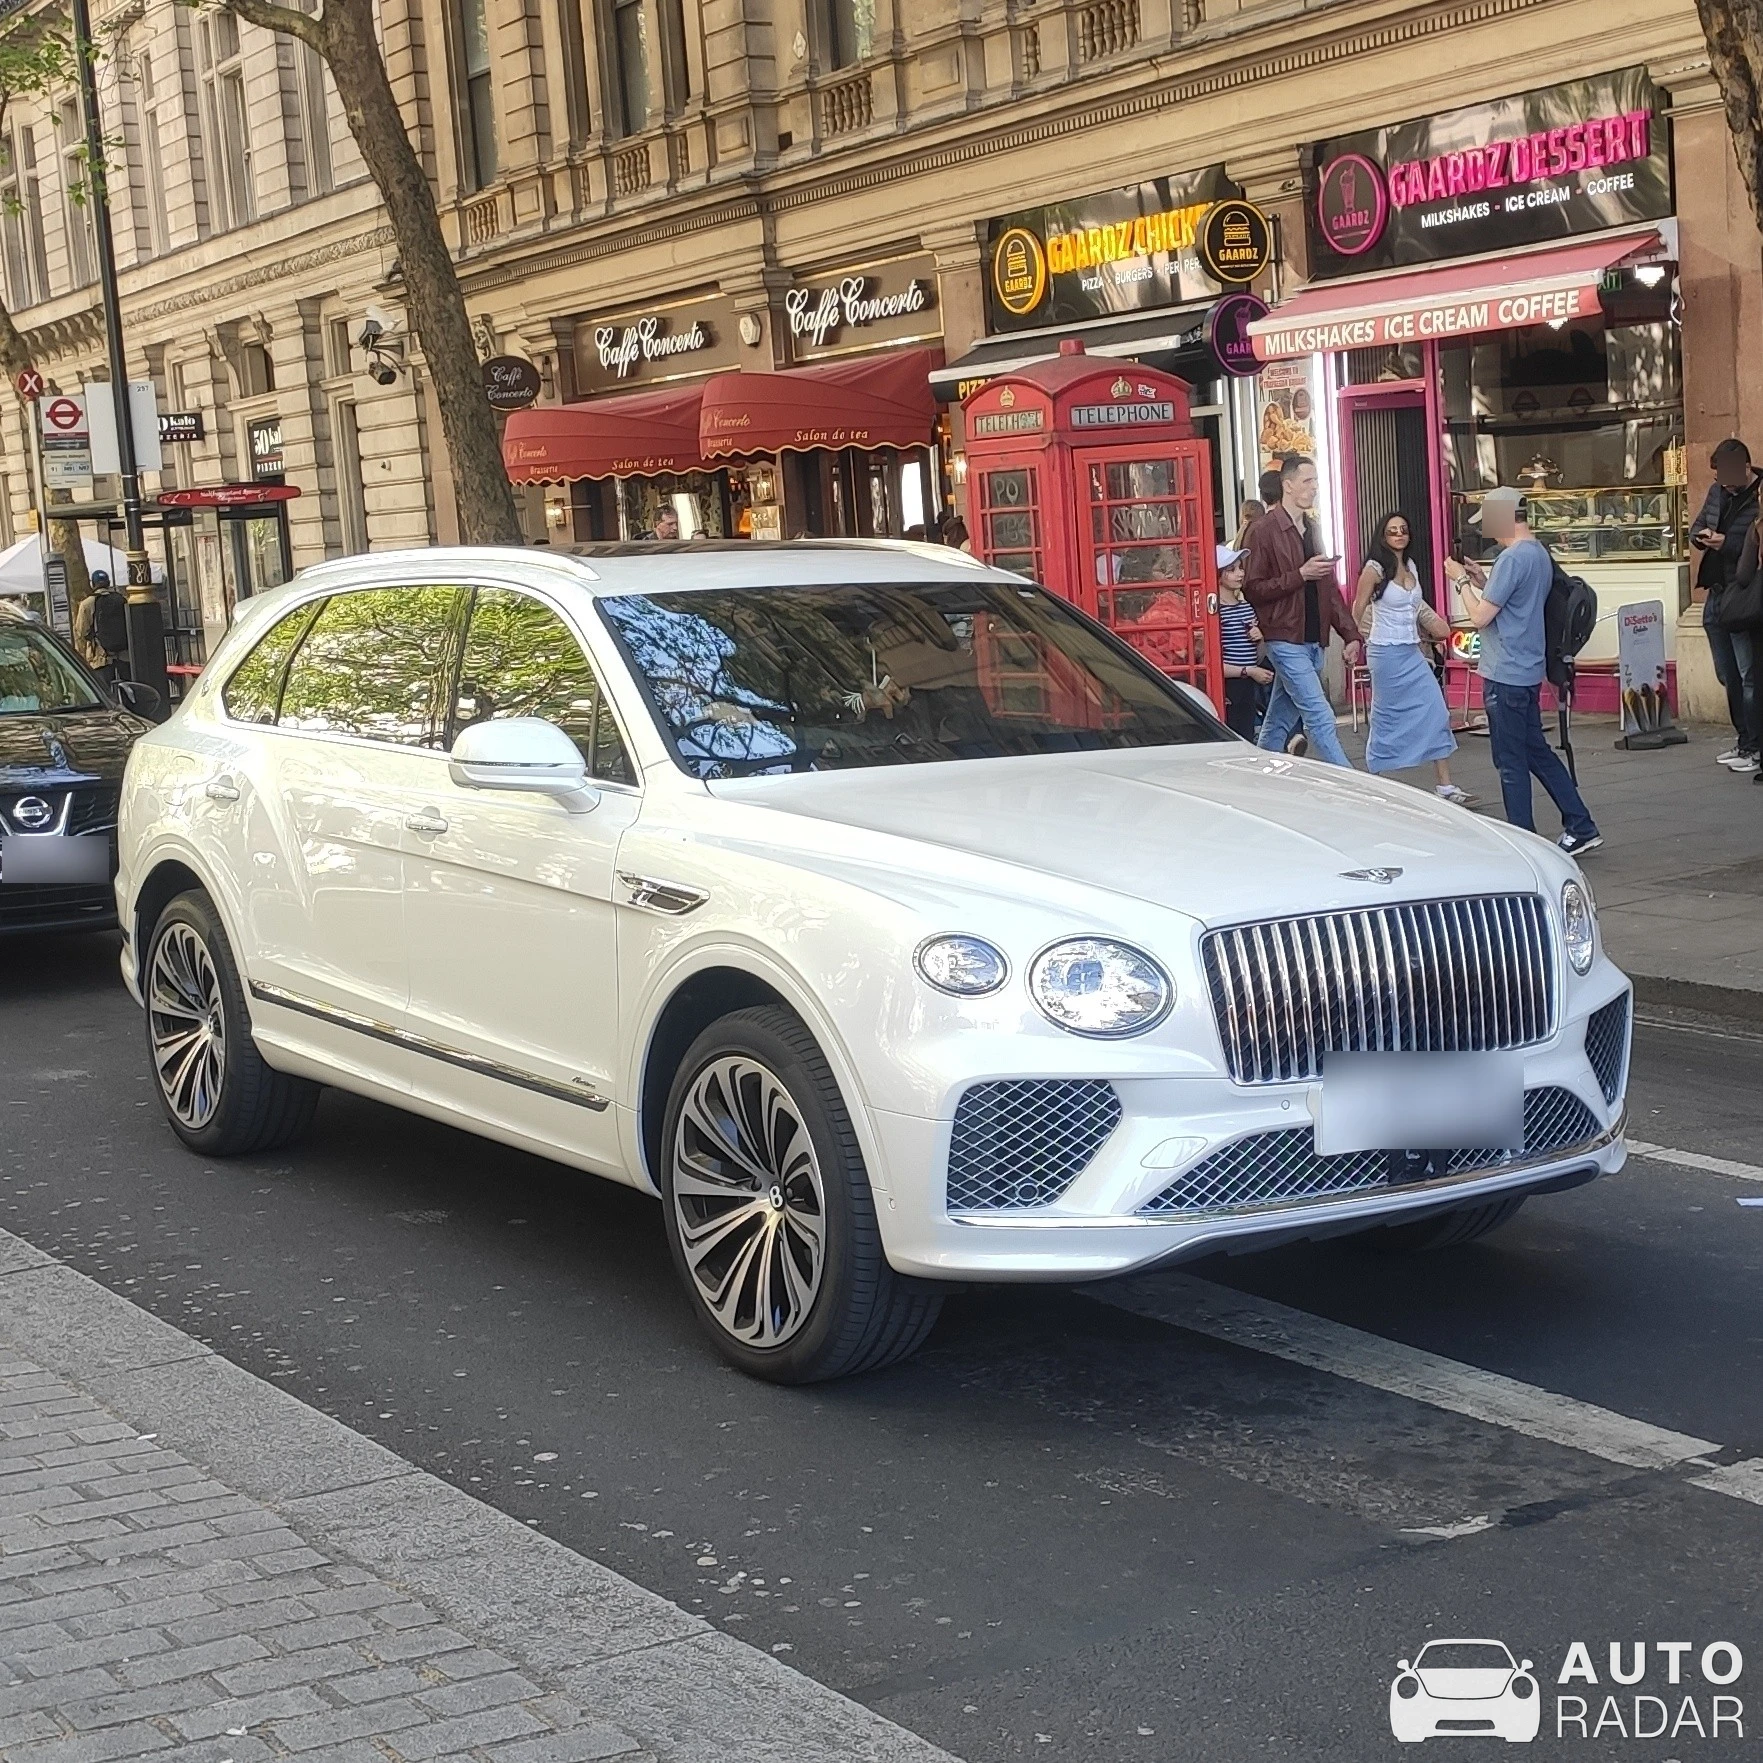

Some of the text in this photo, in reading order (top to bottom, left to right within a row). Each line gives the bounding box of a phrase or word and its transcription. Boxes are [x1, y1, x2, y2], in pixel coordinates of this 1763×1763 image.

[1389, 108, 1652, 207] GAARDZ DESSERT
[1421, 173, 1635, 229] MILKSHAKES ICE CREAM COFFEE
[1332, 209, 1370, 230] GAARDZ
[1047, 202, 1213, 274] GAARDZ CHICK
[1219, 247, 1259, 261] GAARDZ
[1004, 275, 1033, 293] GAARDZ
[1081, 277, 1105, 291] PIZZA
[1115, 266, 1154, 285] BURGERS
[1163, 260, 1183, 275] PERI
[1597, 269, 1618, 291] XIT
[840, 276, 925, 328] Concerto
[1264, 289, 1580, 357] MILKSHAKES ICE CREAM COFFEE
[638, 316, 705, 363] Concerto
[1226, 342, 1252, 354] GAAR
[23, 373, 39, 393] X
[485, 384, 533, 401] Concerto
[958, 378, 992, 400] PIZZ
[158, 417, 168, 431] 0
[713, 409, 751, 429] Concerto
[978, 411, 1041, 433] TELEPHONE
[1074, 403, 1170, 425] TELEPHONE
[159, 433, 197, 441] ZZERIA
[253, 426, 282, 455] 50 kal
[794, 427, 868, 442] Salon de tea
[530, 465, 558, 475] Brasserie
[612, 456, 674, 470] Salon de tea
[1451, 630, 1481, 659] OPE
